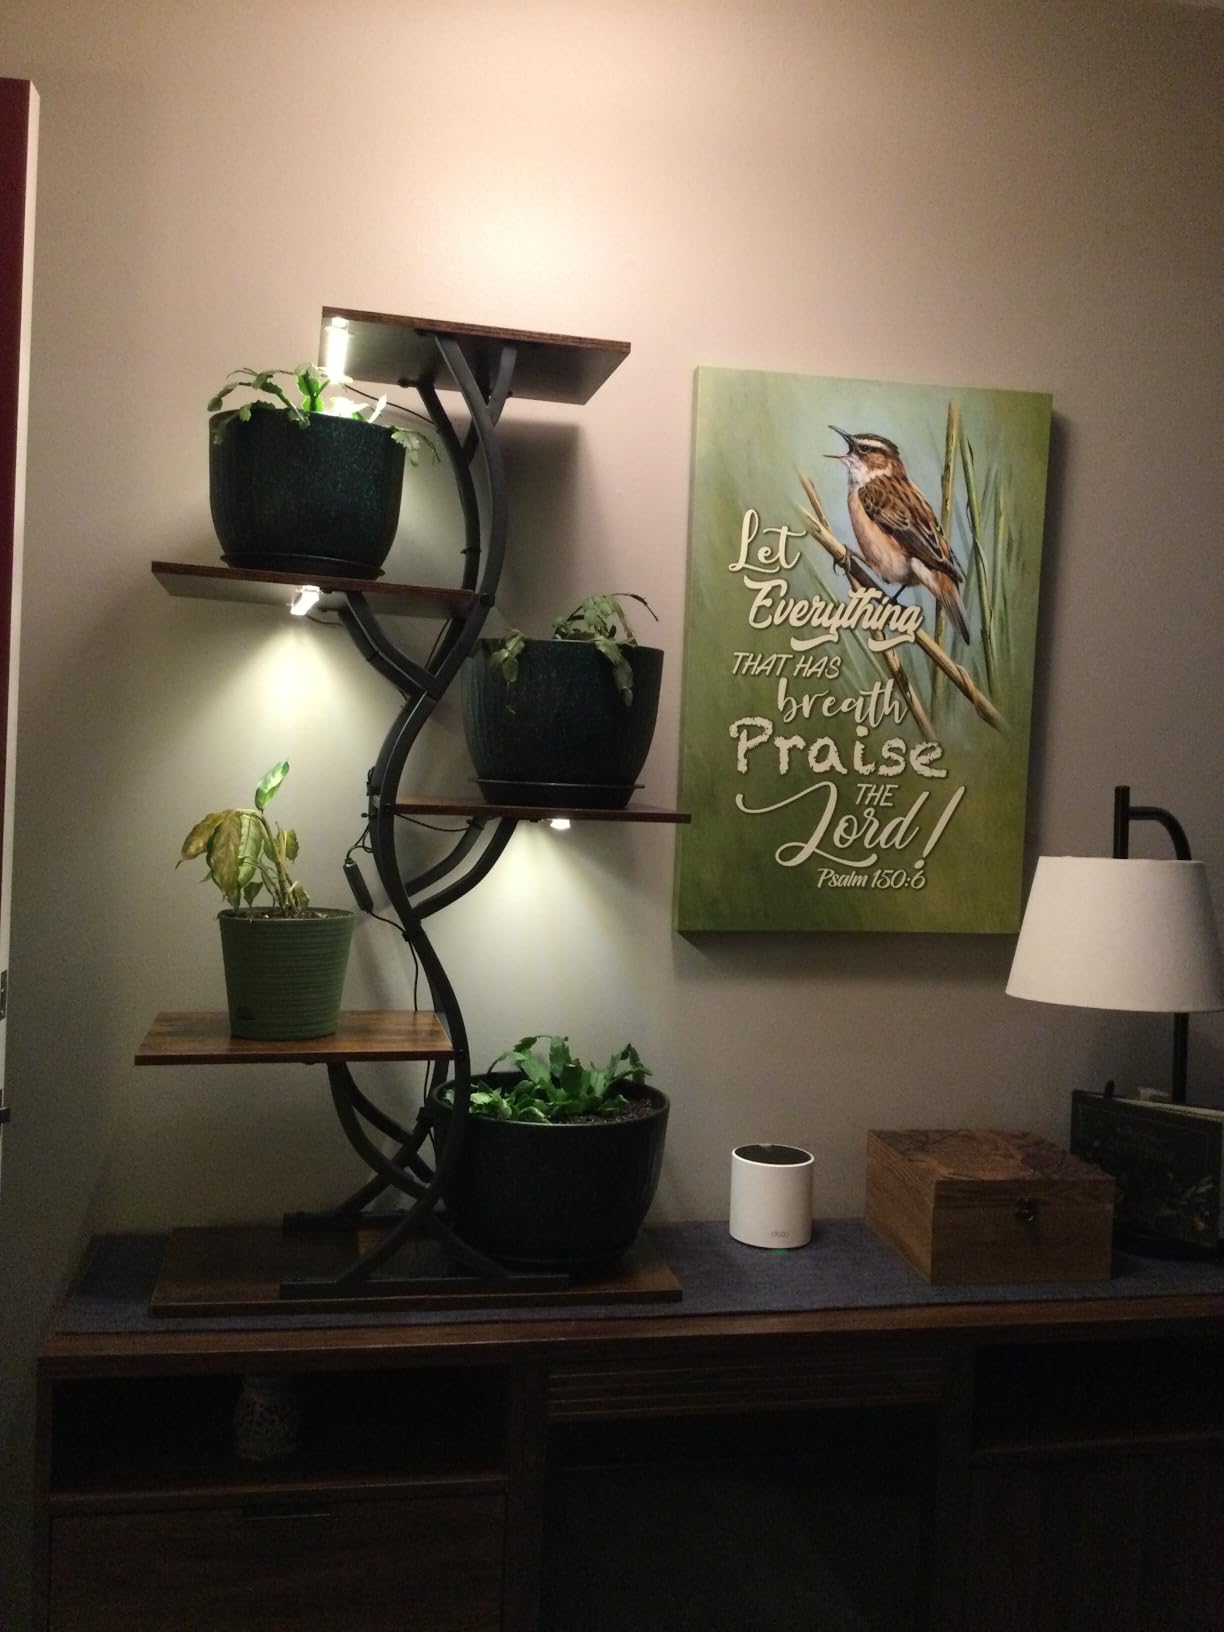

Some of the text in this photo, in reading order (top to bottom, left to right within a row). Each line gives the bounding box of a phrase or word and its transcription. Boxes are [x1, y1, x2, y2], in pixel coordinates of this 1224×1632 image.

[728, 508, 807, 573] Let
[743, 574, 923, 652] Everything
[731, 651, 842, 678] THAT HAS
[777, 676, 909, 728] breath
[729, 715, 948, 778] Praise
[855, 783, 899, 807] THE
[816, 867, 927, 889] Psalm 150:6
